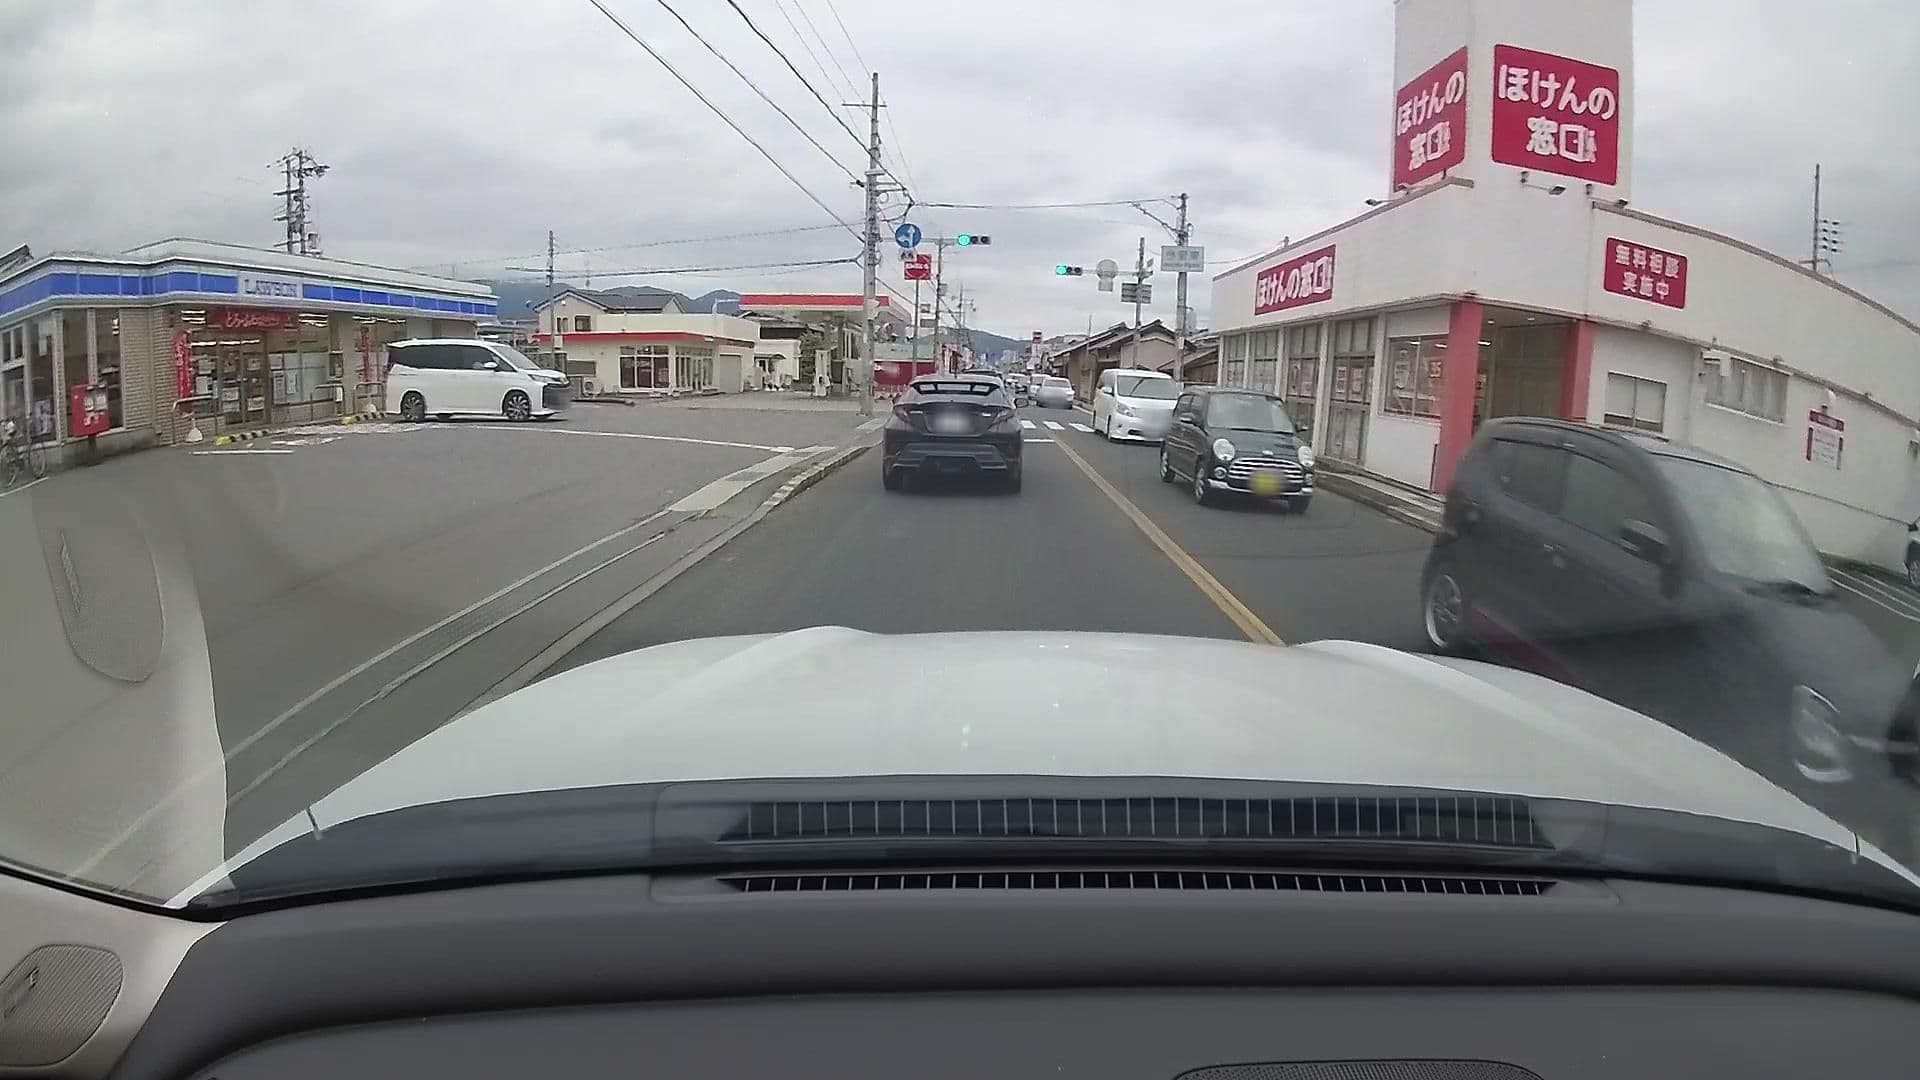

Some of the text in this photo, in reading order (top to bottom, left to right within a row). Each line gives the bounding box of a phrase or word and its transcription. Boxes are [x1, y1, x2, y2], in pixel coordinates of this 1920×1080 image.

[1397, 70, 1466, 137] ほけんの
[1497, 64, 1616, 120] ほけんの
[1408, 121, 1451, 171] 窓口
[1526, 116, 1597, 163] 窓口
[1256, 256, 1333, 308] ほけんの窓口
[1615, 244, 1679, 279] 無料相談
[1622, 271, 1669, 300] 実施中
[244, 279, 297, 298] LAWSON
